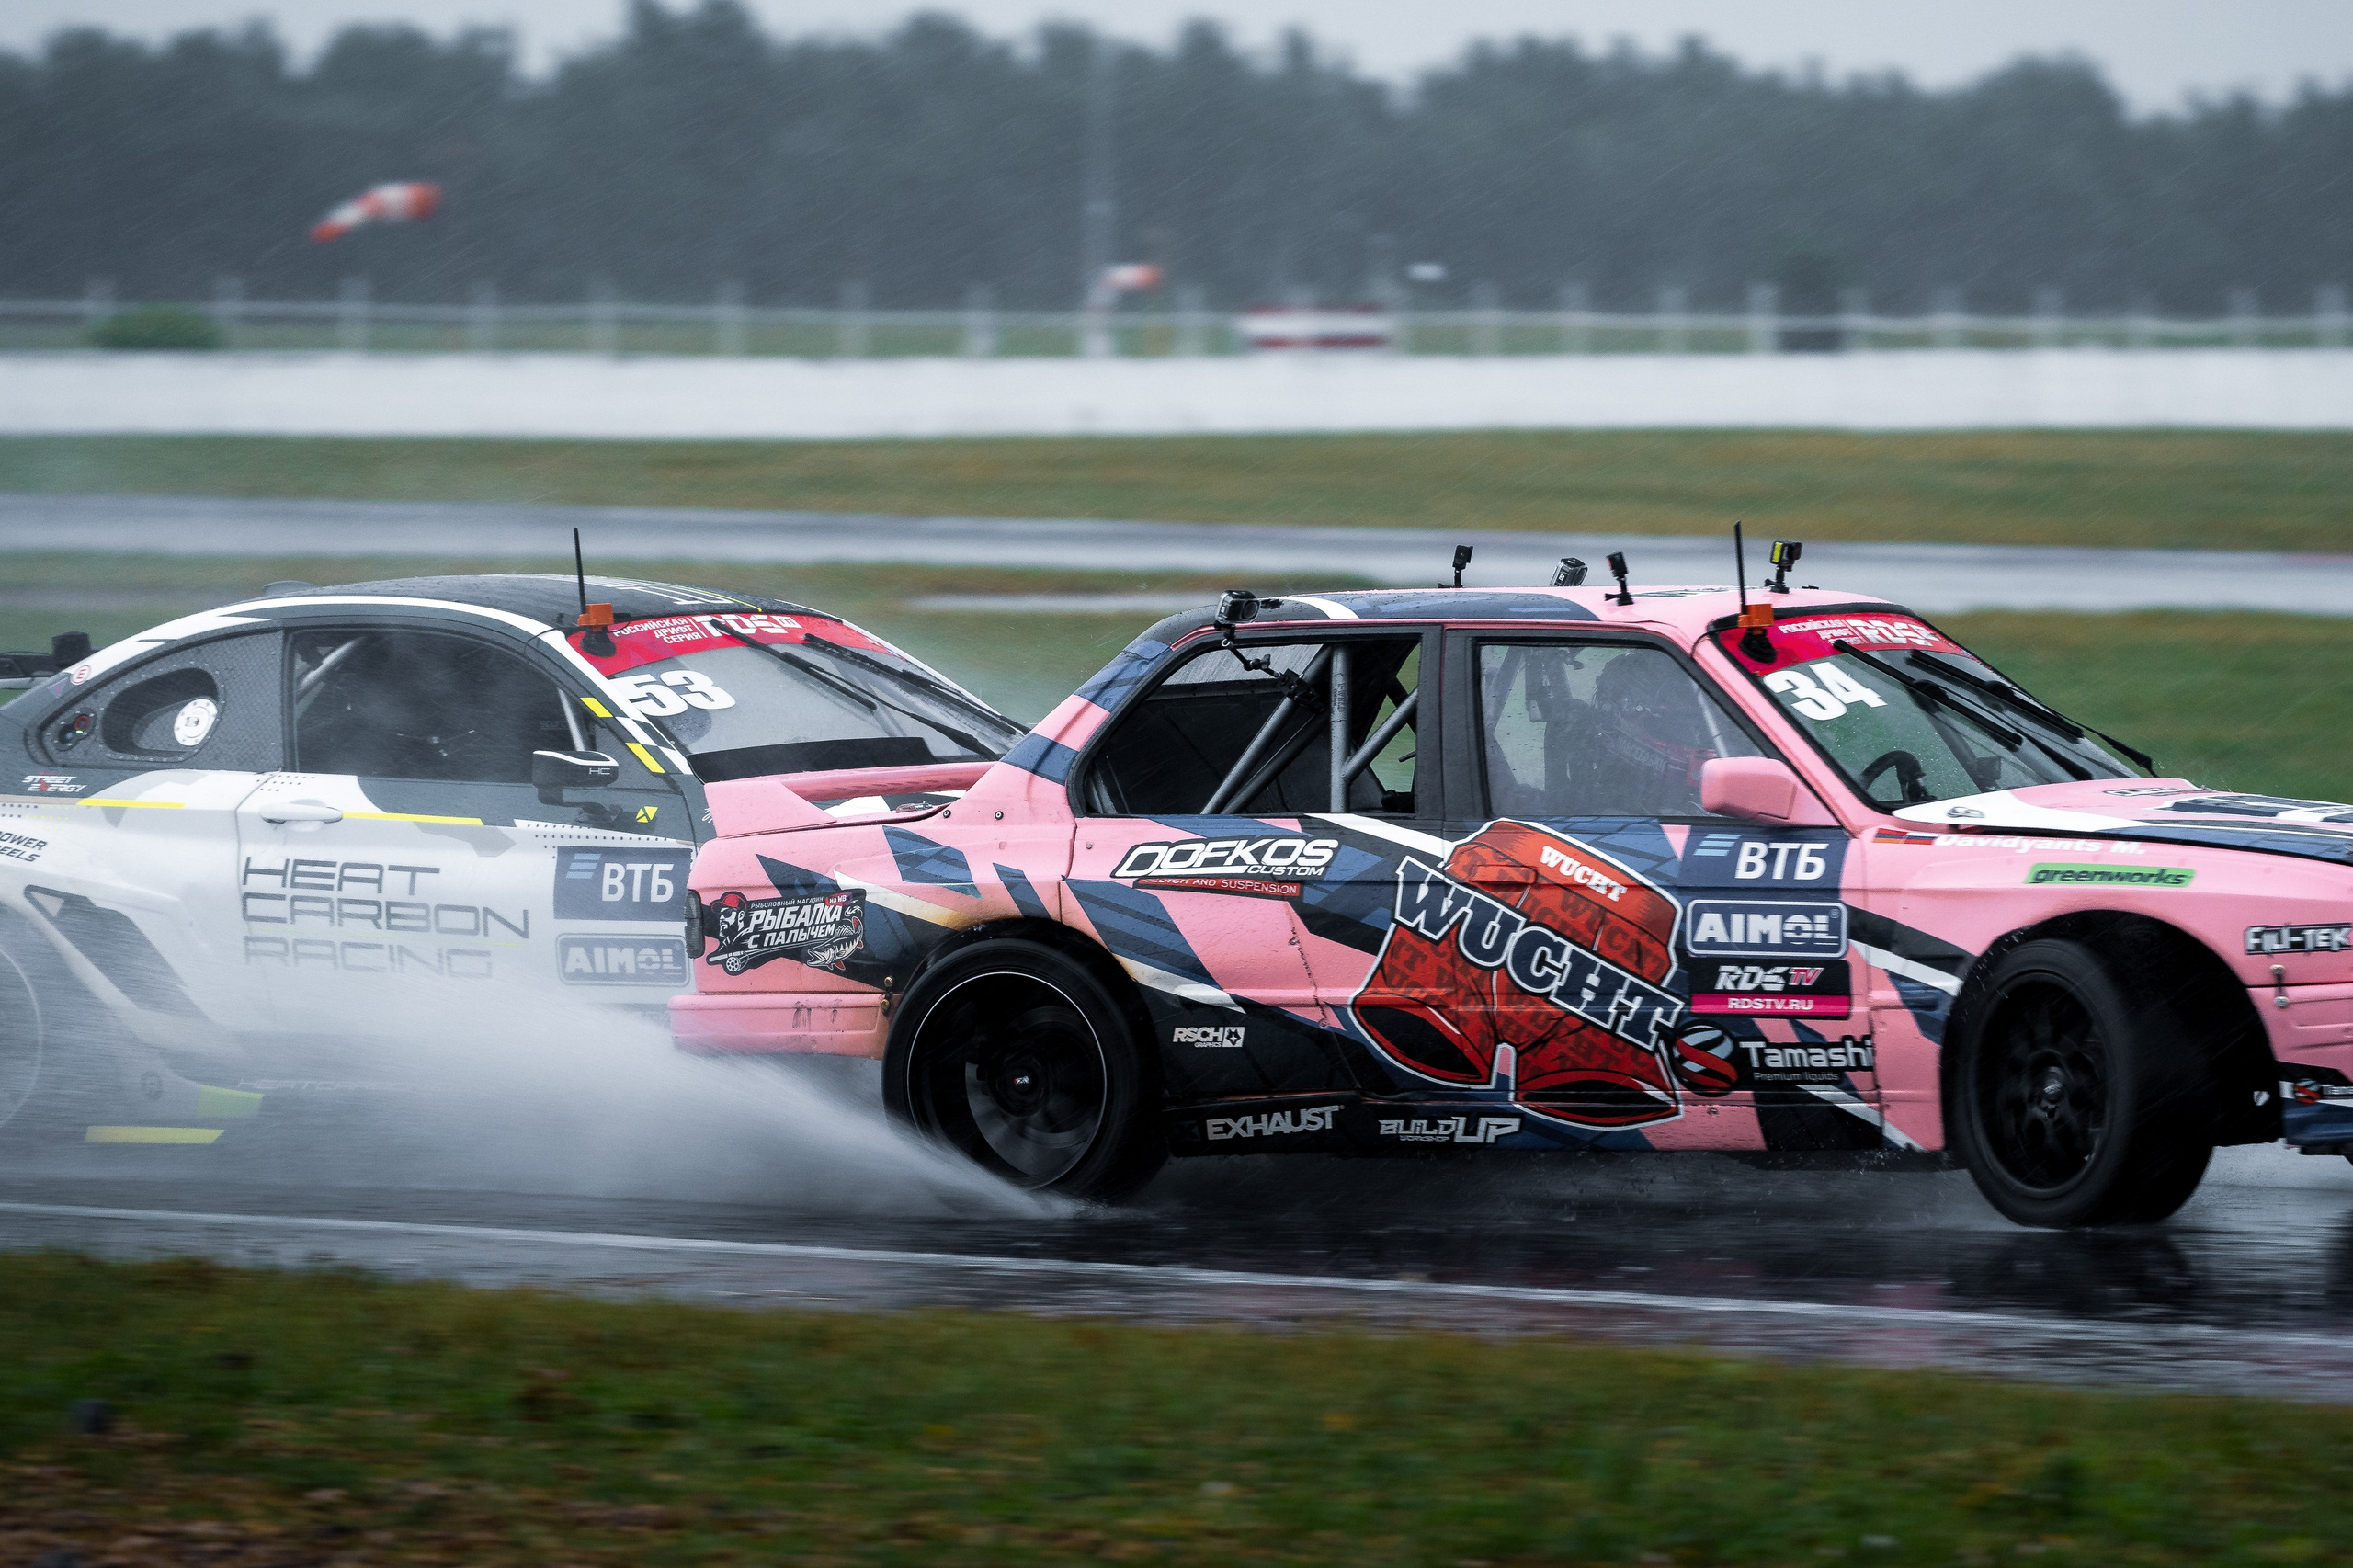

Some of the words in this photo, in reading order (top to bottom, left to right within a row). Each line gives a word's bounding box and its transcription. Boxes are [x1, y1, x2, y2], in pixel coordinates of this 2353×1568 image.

[653, 624, 694, 639] ДРИФТ
[663, 631, 702, 644] СЕРИЯ
[608, 670, 735, 716] 53
[1762, 662, 1888, 720] 34
[0, 846, 40, 862] EELS
[1934, 834, 2104, 853] Davidyants
[1246, 865, 1325, 876] CUSTOM
[1540, 845, 1629, 903] WUCHT
[1734, 841, 1830, 880] ВТБ
[243, 856, 440, 895] HEAT
[602, 862, 674, 903] ВТБ
[1193, 879, 1217, 887] AND
[1221, 880, 1297, 895] SUSPENSION
[2030, 867, 2191, 885] greenworks
[242, 892, 530, 938] CARBON
[751, 898, 795, 909] РЫБОЛОВНЫЙ
[796, 896, 824, 905] МАГАЗИН
[749, 903, 843, 933] РЫБАЛКА
[1693, 913, 1839, 946] AIMOL
[763, 924, 835, 947] ПАЛЫЧЕМ
[244, 935, 493, 978] RACING
[565, 947, 682, 975] AIMOL
[1394, 855, 1685, 1051] WUCHT
[1727, 997, 1814, 1010] RDSTV.RU
[1173, 1027, 1224, 1043] RSCH
[1739, 1040, 1873, 1068] Tamashi
[1754, 1072, 1802, 1081] Premium
[1206, 1105, 1340, 1141] EXHAUST
